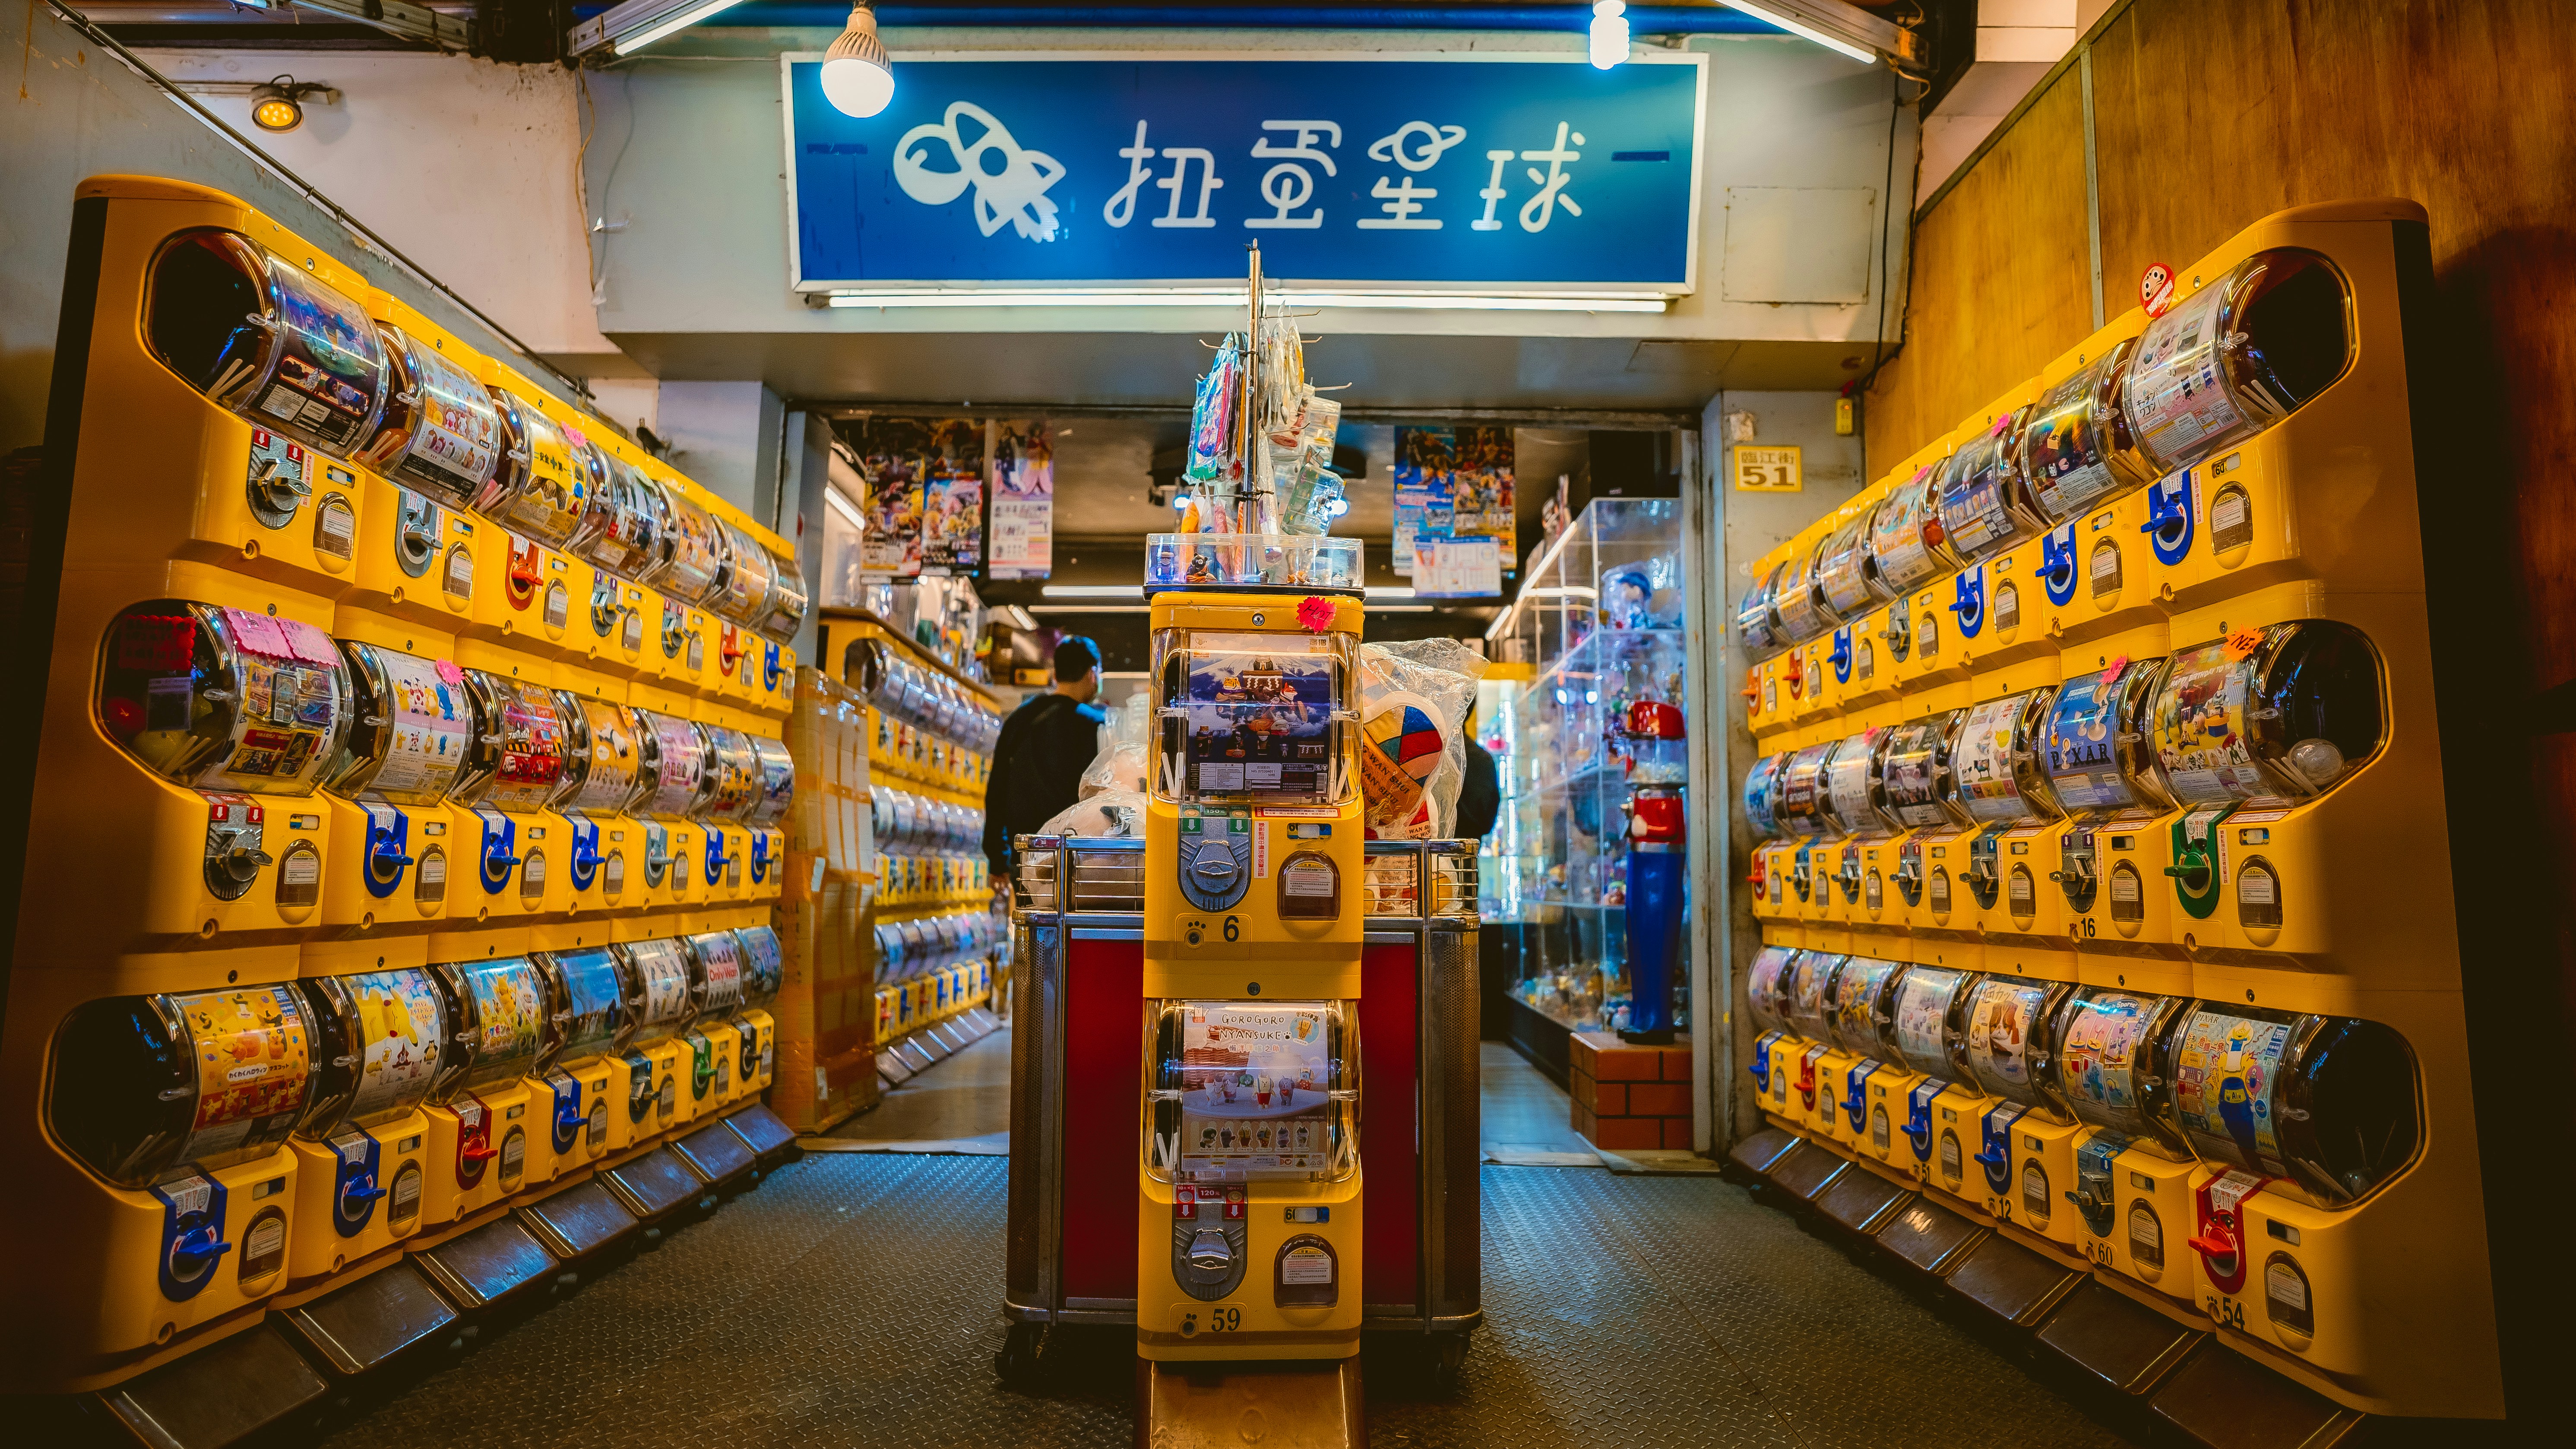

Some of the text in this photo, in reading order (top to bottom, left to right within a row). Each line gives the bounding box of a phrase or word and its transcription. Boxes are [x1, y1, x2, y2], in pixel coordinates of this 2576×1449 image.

[1104, 119, 1584, 234] 扭蛋星球
[1741, 451, 1795, 465] 臨江街
[1743, 466, 1795, 486] 51
[1303, 604, 1334, 622] HOT
[2176, 659, 2189, 671] TOY
[2170, 676, 2189, 687] HAPPY
[2188, 669, 2215, 682] BIRTHDAY
[2215, 665, 2224, 674] TO
[1369, 753, 1410, 795] WAN SHUI
[1223, 915, 1239, 942] 6
[2081, 917, 2095, 938] 16
[2196, 1014, 2219, 1024] PIXAR
[1219, 1030, 1281, 1041] NYANSUKE
[1228, 1044, 1280, 1053] 懶洋洋喵之助
[1999, 1197, 2011, 1221] 12
[2098, 1243, 2113, 1266] 60
[1211, 1308, 1241, 1332] 59
[2223, 1296, 2245, 1332] 54
